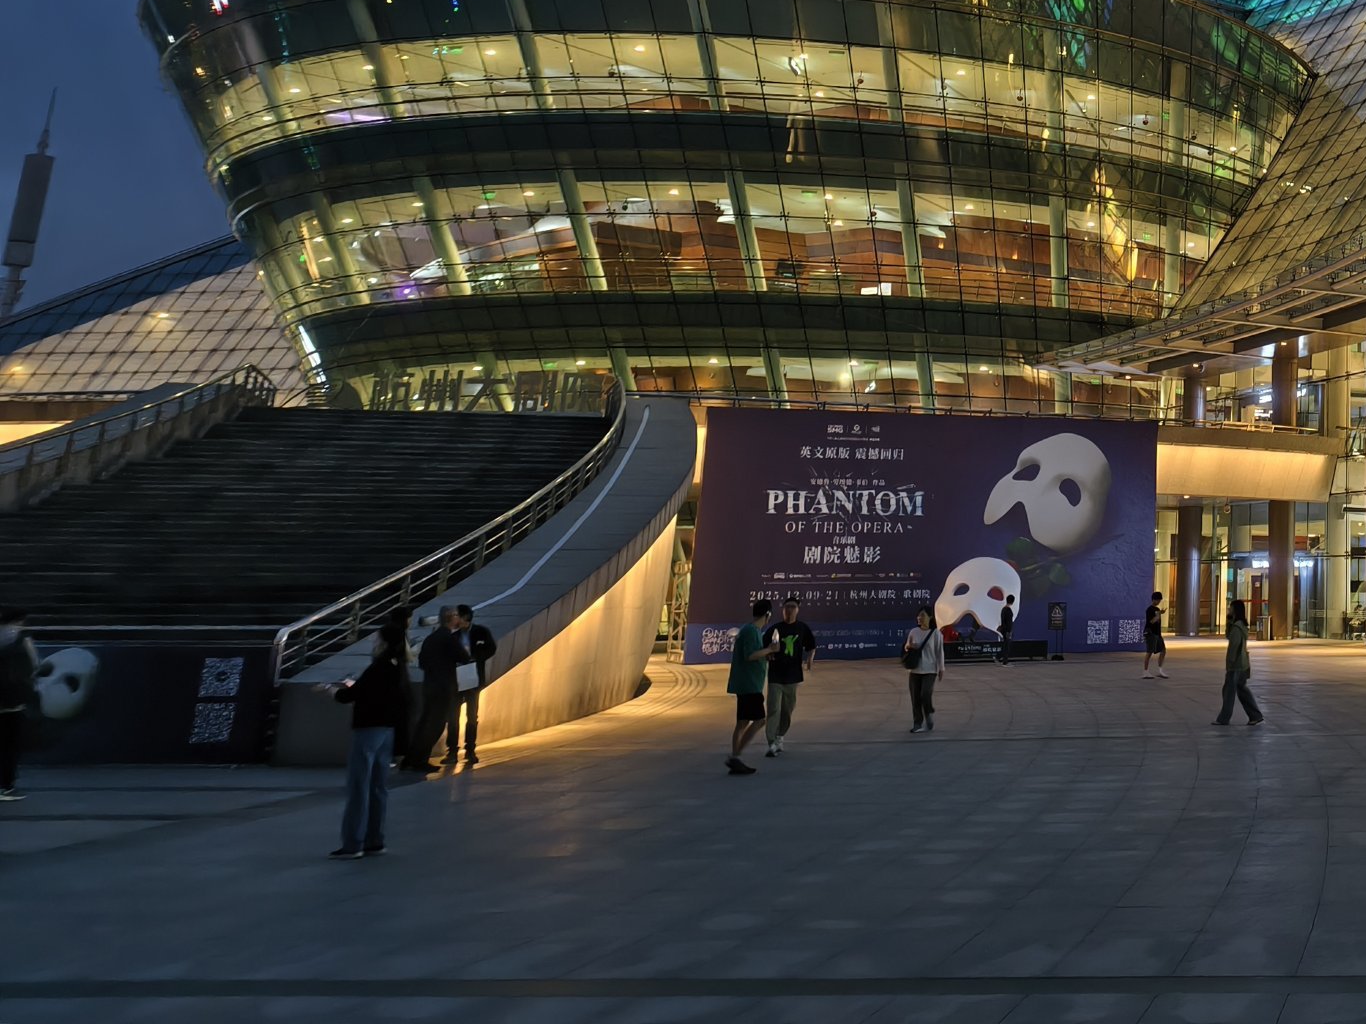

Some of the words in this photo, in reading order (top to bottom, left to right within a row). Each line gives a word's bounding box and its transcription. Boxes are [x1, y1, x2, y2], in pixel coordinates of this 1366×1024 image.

[800, 445, 850, 459] 英文原版
[855, 447, 904, 461] 震撼回归
[766, 489, 925, 516] PHANTOM
[785, 521, 806, 533] OF
[814, 521, 844, 534] THE
[851, 521, 904, 534] OPERA
[803, 545, 881, 564] 剧院魅影
